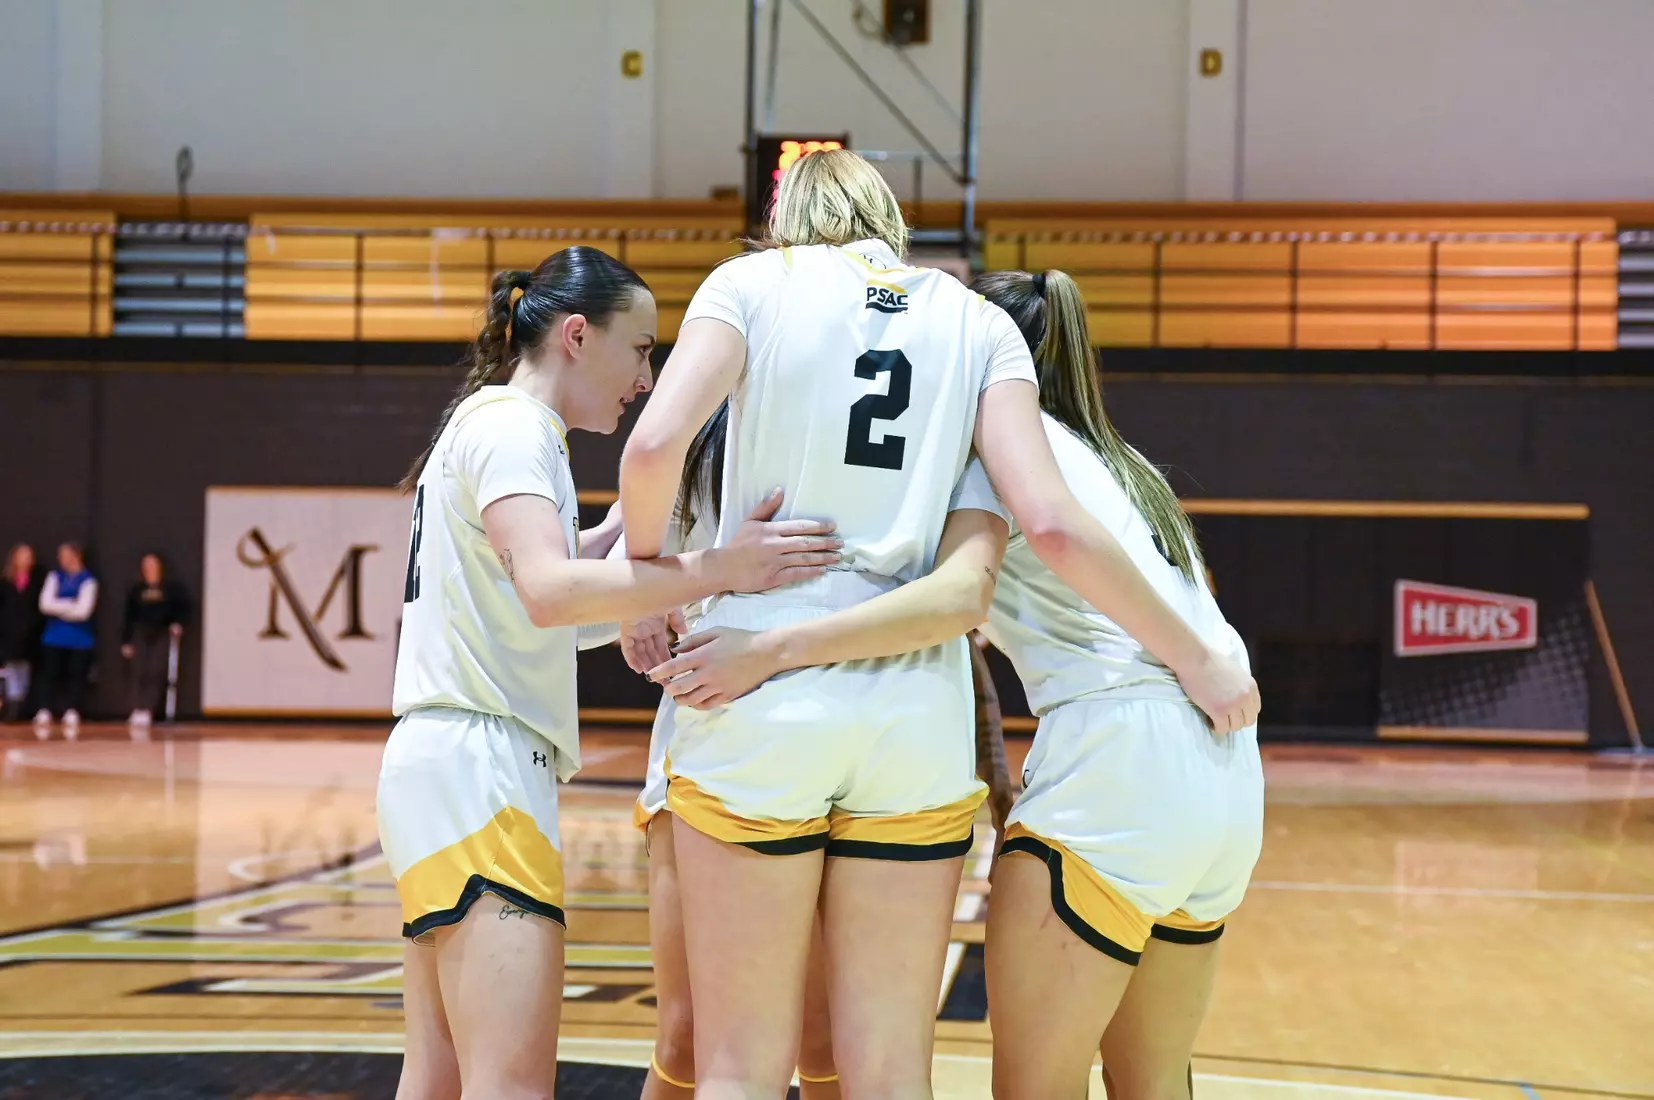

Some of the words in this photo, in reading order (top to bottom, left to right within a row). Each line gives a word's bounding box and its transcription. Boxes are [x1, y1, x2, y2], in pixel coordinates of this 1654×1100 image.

[621, 50, 643, 78] C
[1200, 48, 1222, 78] D
[866, 286, 909, 306] PSAC
[844, 348, 912, 471] 2
[236, 524, 382, 673] M
